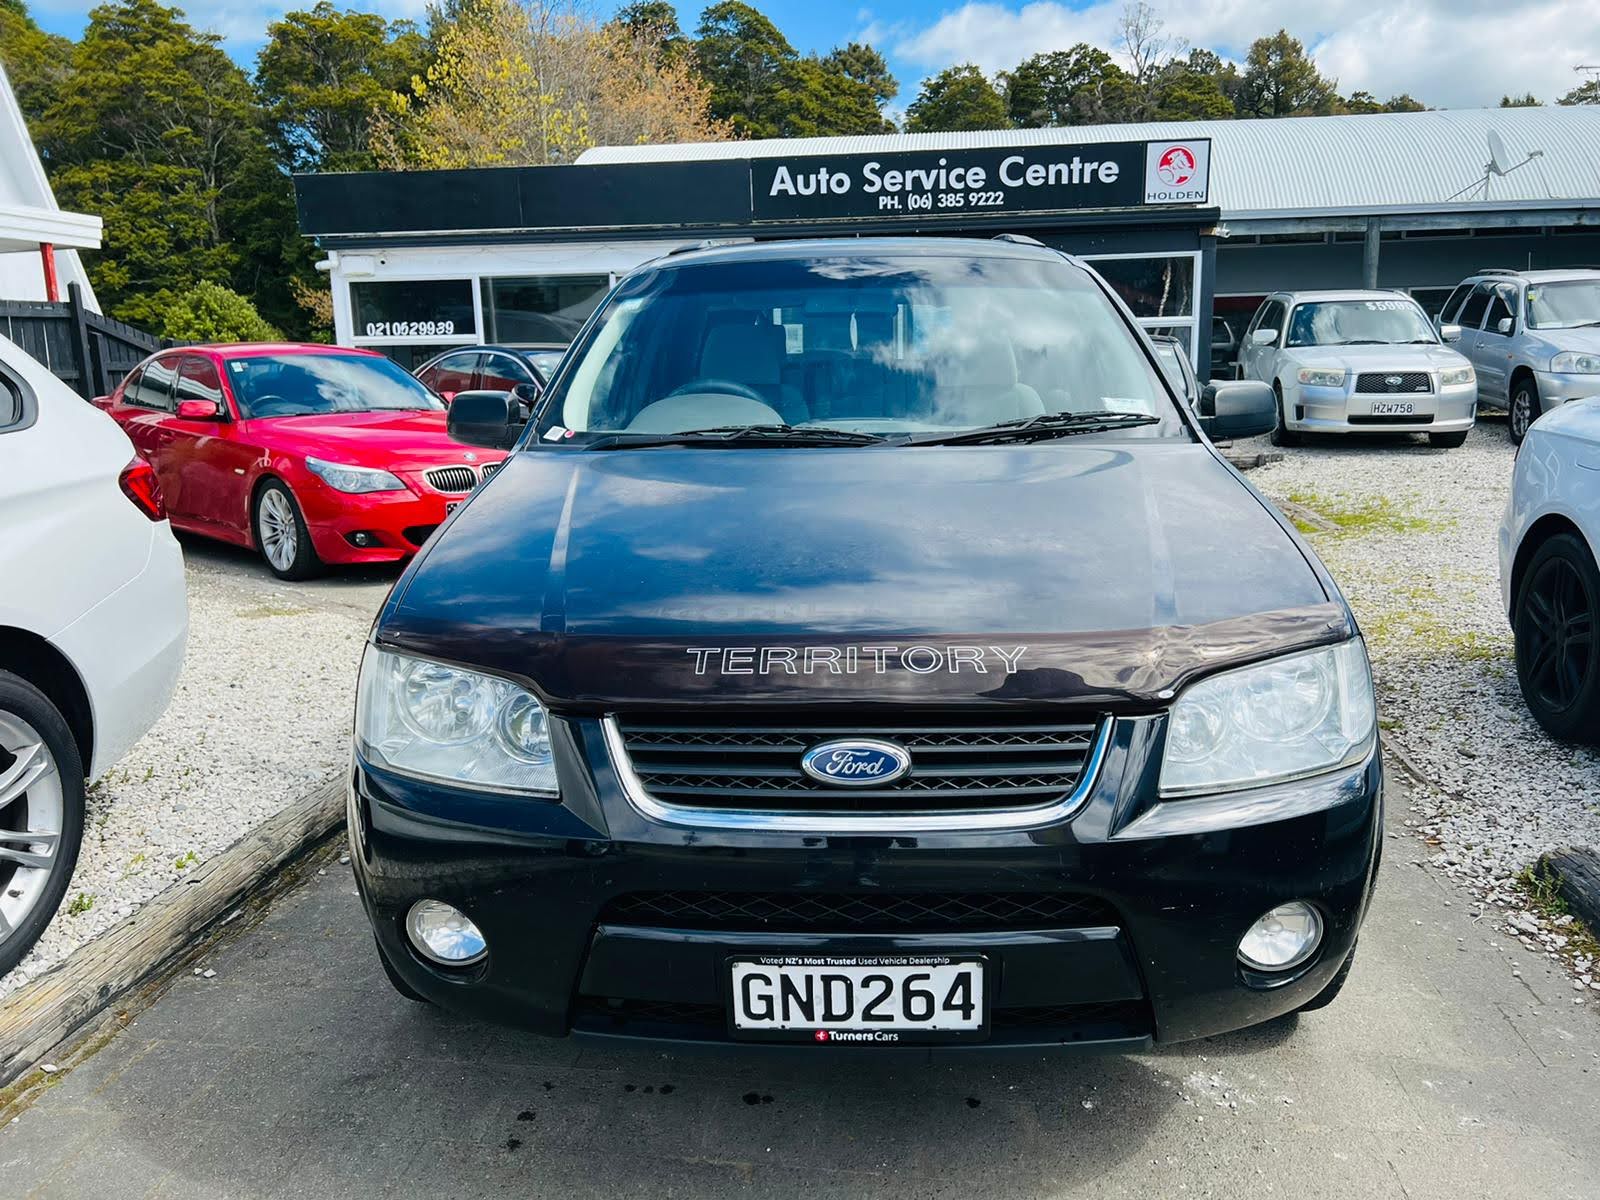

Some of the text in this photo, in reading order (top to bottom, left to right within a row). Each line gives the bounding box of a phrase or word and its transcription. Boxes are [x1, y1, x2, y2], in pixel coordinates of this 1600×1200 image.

[769, 154, 1120, 197] Auto Service Centre
[878, 191, 1004, 210] PH. (06) 385 9222
[1147, 191, 1204, 201] HOLDEN
[1373, 403, 1413, 413] HZW758
[686, 646, 1028, 675] TERRITORY
[825, 751, 885, 775] Ford
[760, 956, 950, 965] Voted NZ's Most Trusted Used Vehicle Dealership
[741, 973, 976, 1022] GND264
